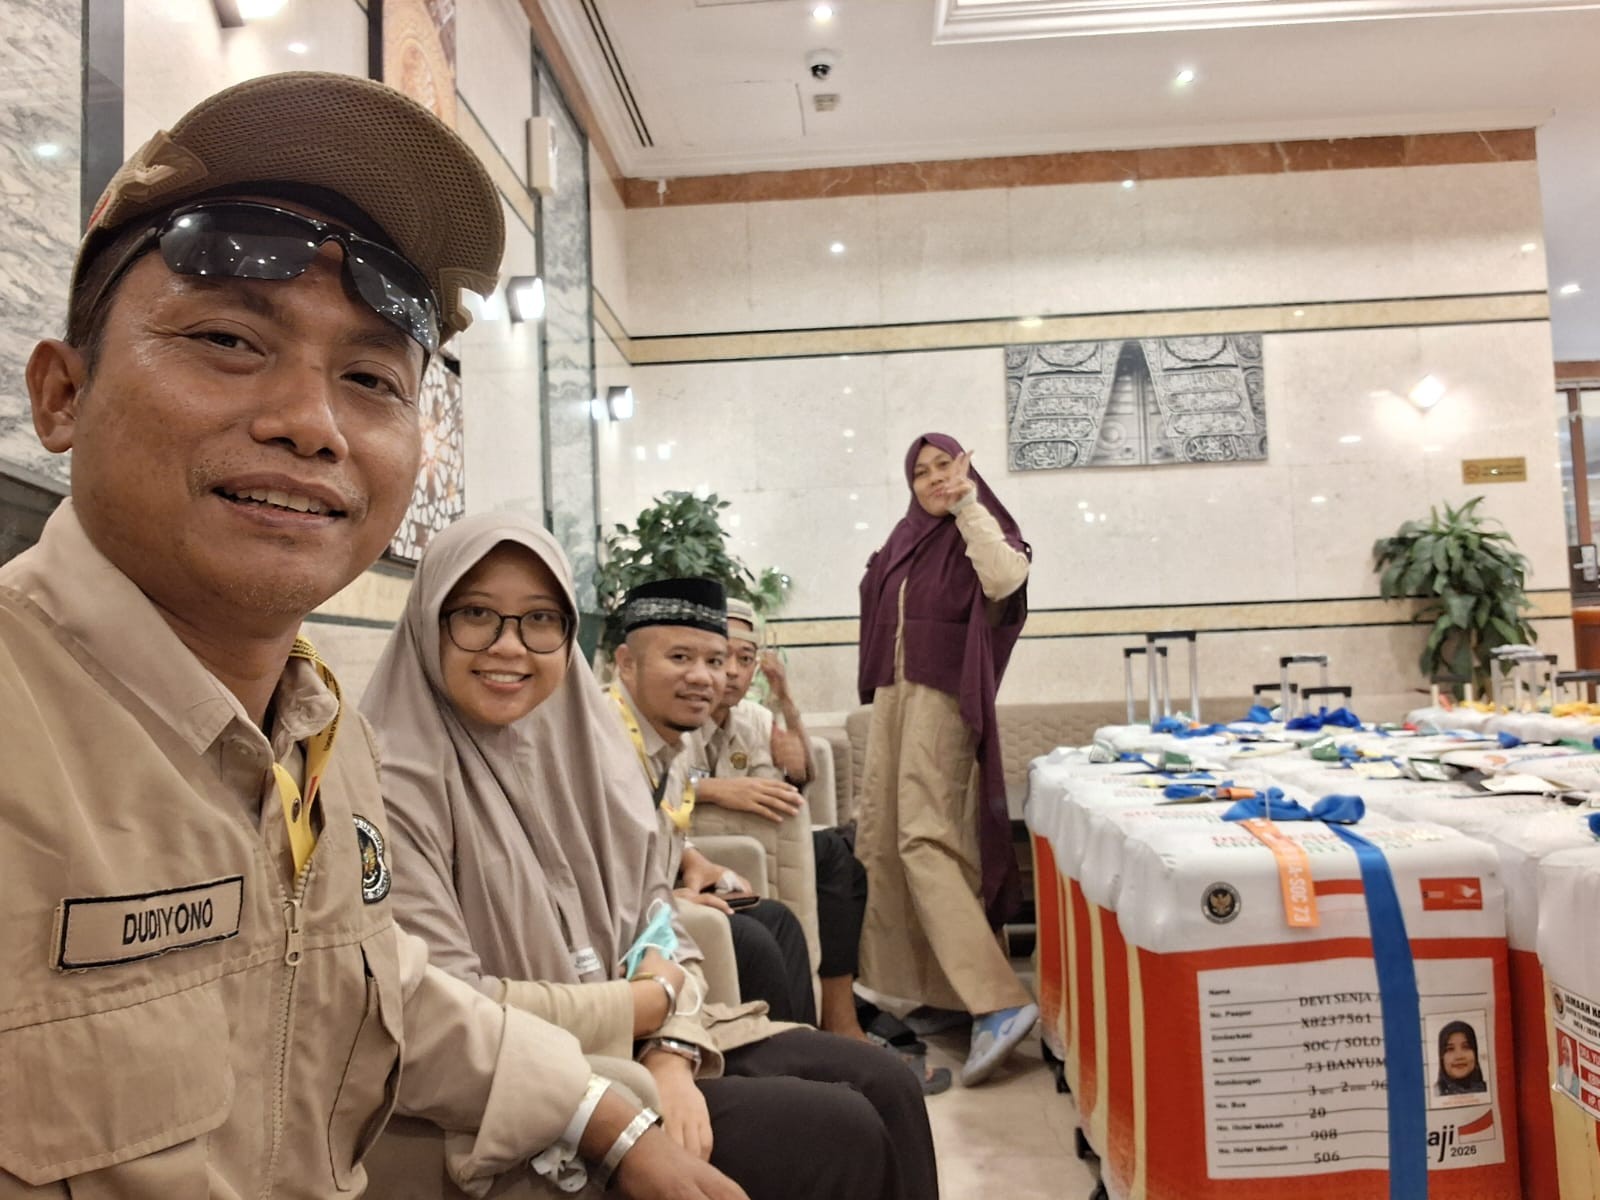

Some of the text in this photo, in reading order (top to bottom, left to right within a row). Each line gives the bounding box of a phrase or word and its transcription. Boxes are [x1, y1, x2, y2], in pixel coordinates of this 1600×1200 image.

[122, 898, 213, 945] DUDIYONO
[1299, 995, 1331, 1007] DEVI
[1333, 992, 1372, 1004] SENJA
[1303, 1040, 1330, 1052] SOC
[1344, 1036, 1381, 1049] SOLO
[1305, 1061, 1322, 1073] 73
[1340, 1081, 1349, 1093] 2
[1309, 1107, 1327, 1119] 20
[1311, 1127, 1338, 1141] 908
[1427, 1124, 1455, 1163] aji
[1314, 1150, 1340, 1164] 506
[1450, 1145, 1477, 1157] 2026
